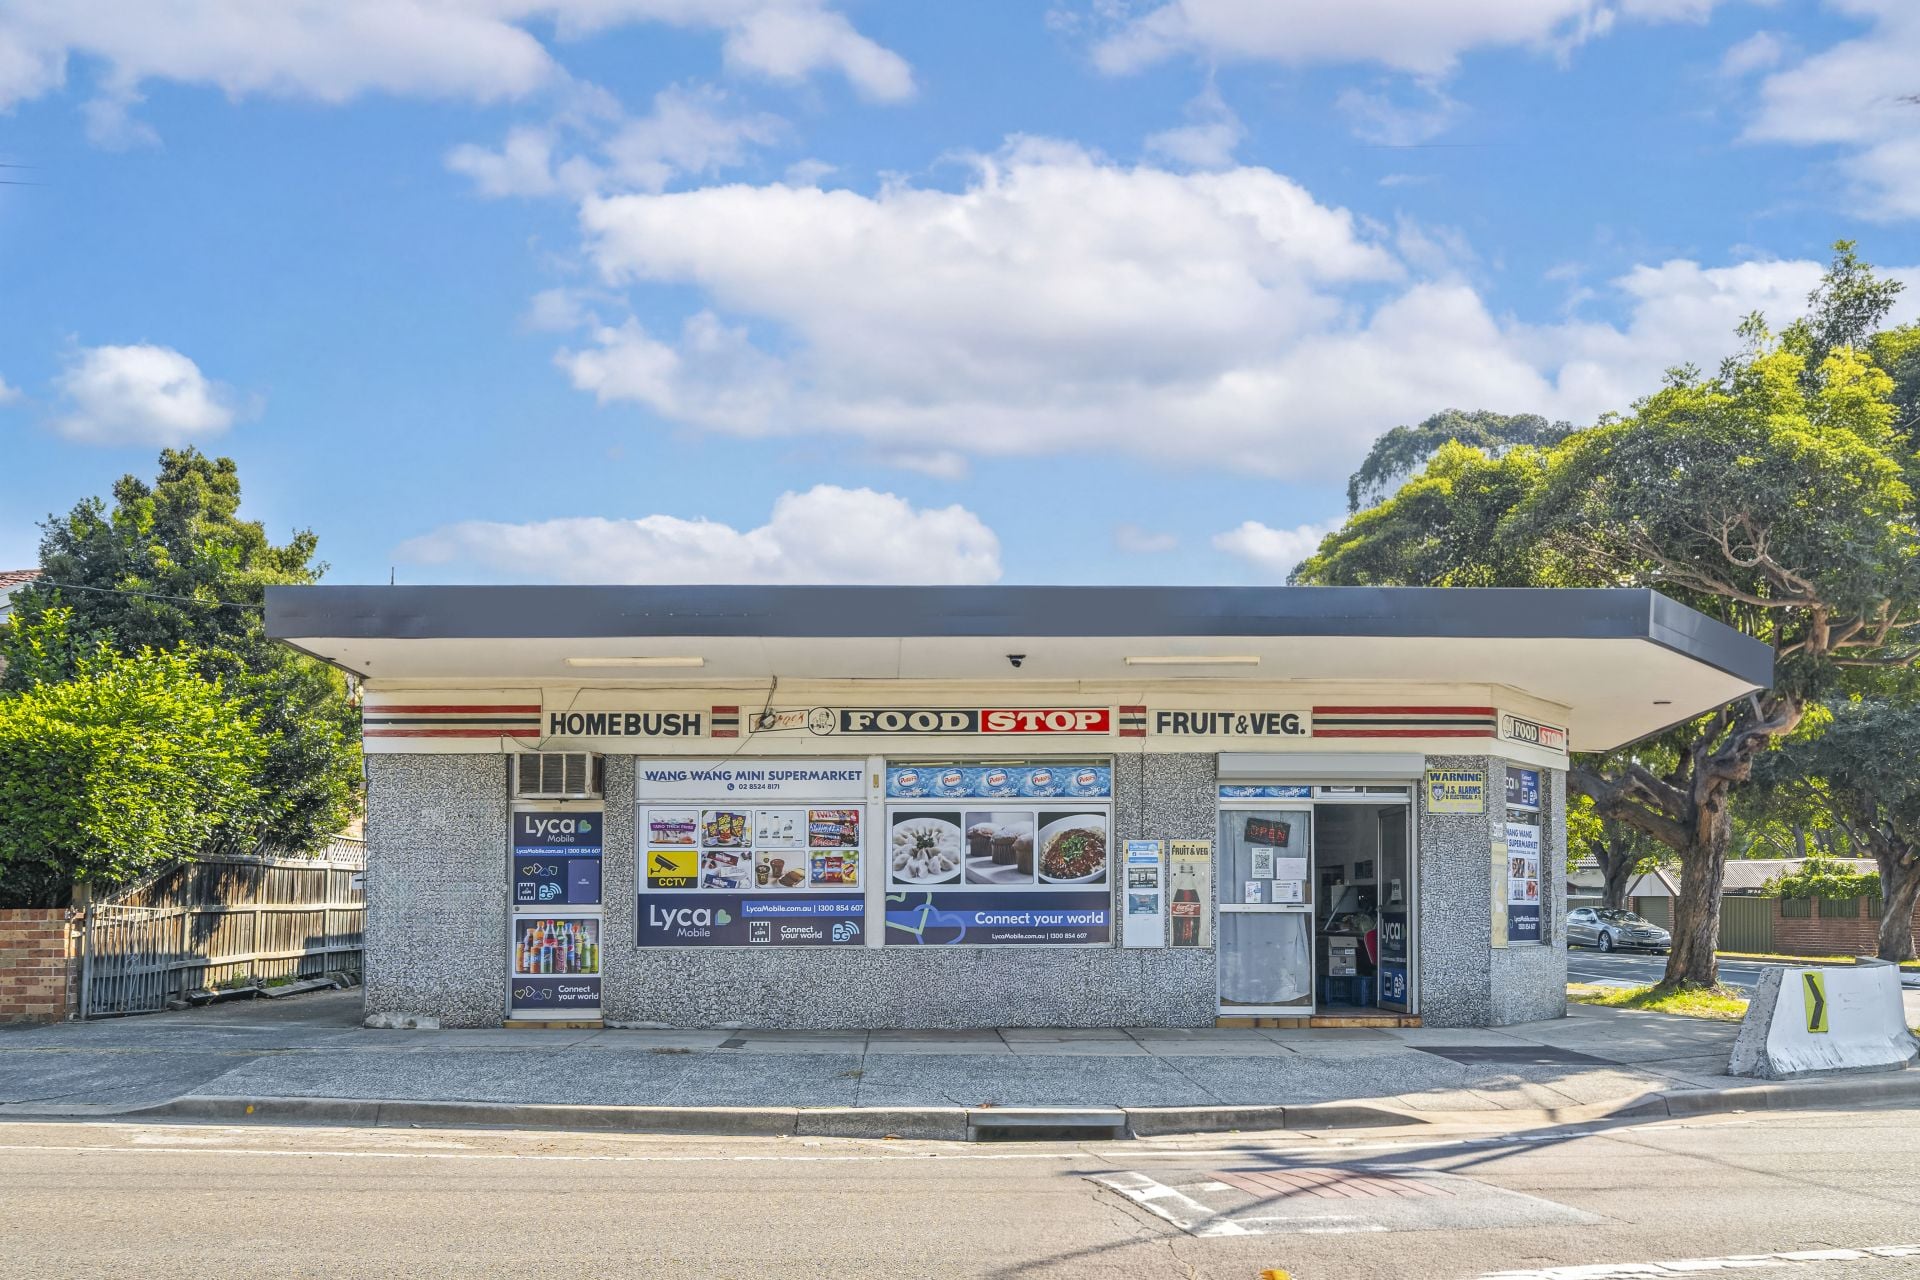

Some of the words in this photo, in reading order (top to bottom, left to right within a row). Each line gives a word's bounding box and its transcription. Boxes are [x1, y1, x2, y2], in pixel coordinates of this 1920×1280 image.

[550, 713, 701, 736] HOMEBUSH
[848, 711, 970, 731] FOOD
[987, 711, 1103, 731] STOP
[1156, 711, 1306, 735] FRUIT&VEG.
[1514, 721, 1538, 741] FOOD
[1541, 729, 1563, 747] STOP
[645, 770, 687, 781] WANG
[690, 770, 732, 781] WANG
[735, 770, 765, 781] MINI
[768, 770, 863, 781] SUPERMARKET
[1430, 773, 1482, 782] WARNING
[1458, 785, 1482, 795] ALARMS
[525, 815, 576, 837] Lyca
[547, 834, 575, 843] Mobile
[1248, 824, 1286, 843] OPEN
[1508, 839, 1539, 849] SUPERMARKET
[1171, 847, 1189, 856] FRUIT
[1189, 847, 1196, 856] &
[1195, 847, 1209, 856] VEG
[658, 877, 687, 887] CCTV
[746, 905, 812, 913] LycaMobile.com.au
[818, 904, 834, 912] 1300
[835, 904, 851, 912] 854
[851, 904, 864, 912] 607
[650, 904, 711, 931] Lyca
[974, 911, 1030, 924] Connect
[1033, 914, 1064, 927] your
[1066, 911, 1104, 924] world
[676, 928, 711, 938] Mobile
[780, 925, 814, 933] Connect
[1381, 919, 1401, 944] Lyca
[780, 933, 799, 941] your
[800, 931, 823, 939] world
[991, 932, 1045, 940] LycaMobile.com.au
[558, 985, 591, 993] Connect
[558, 993, 576, 1001] your
[576, 992, 599, 1000] world
